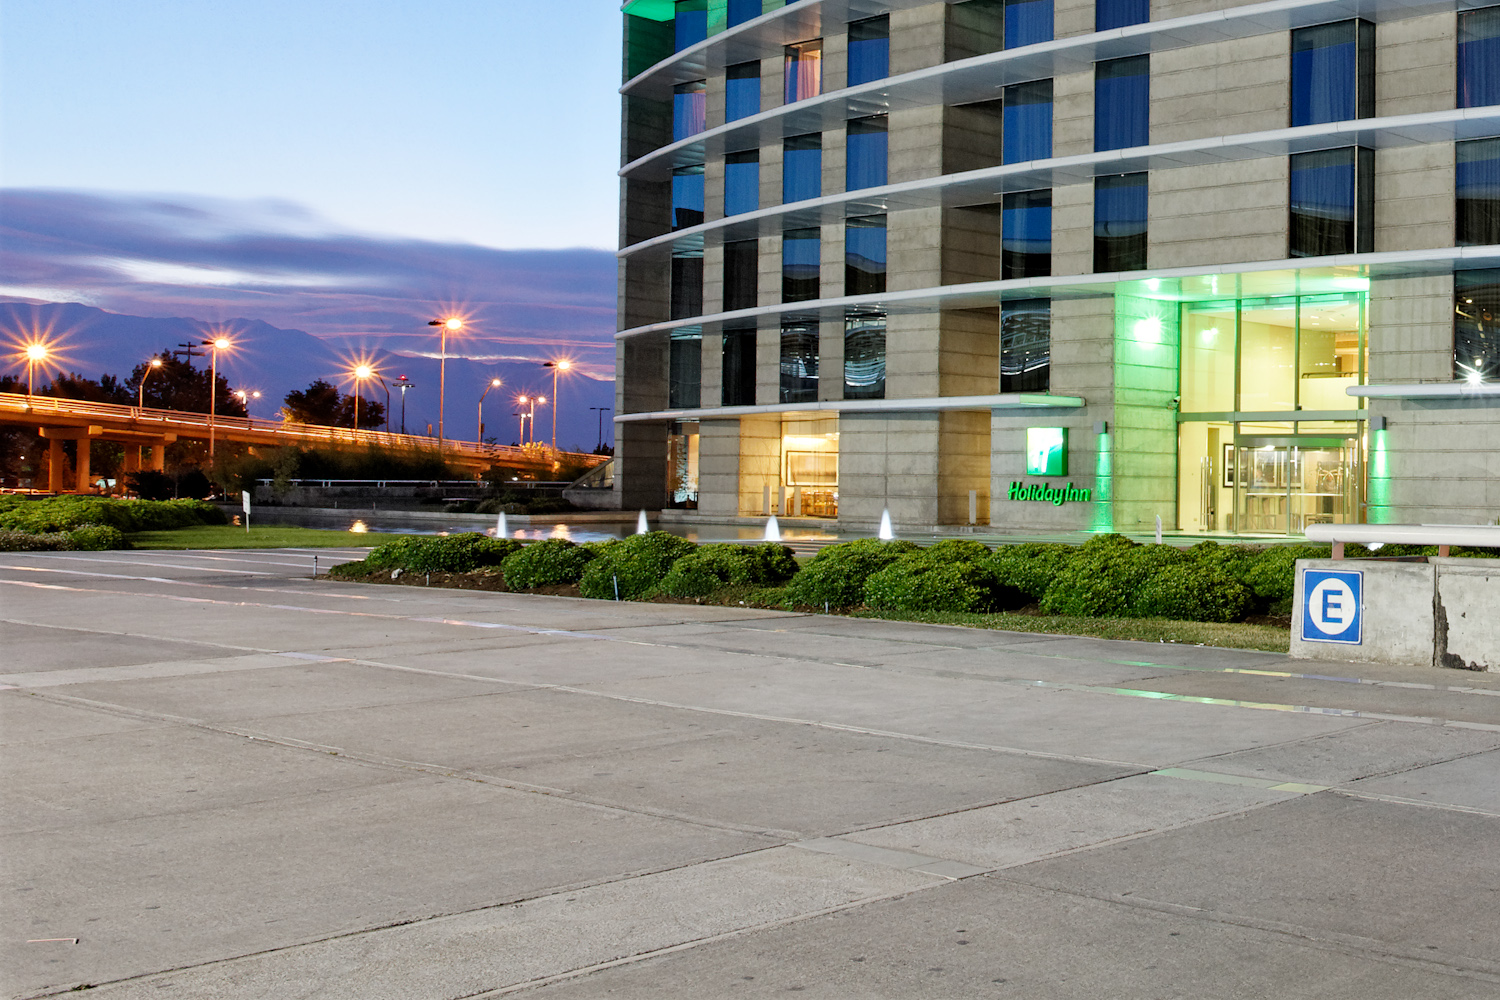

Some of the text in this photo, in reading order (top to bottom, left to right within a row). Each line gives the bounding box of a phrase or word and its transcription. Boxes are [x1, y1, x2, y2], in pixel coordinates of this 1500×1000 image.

[1008, 481, 1091, 506] Holiday Inn
[1322, 589, 1343, 624] E
